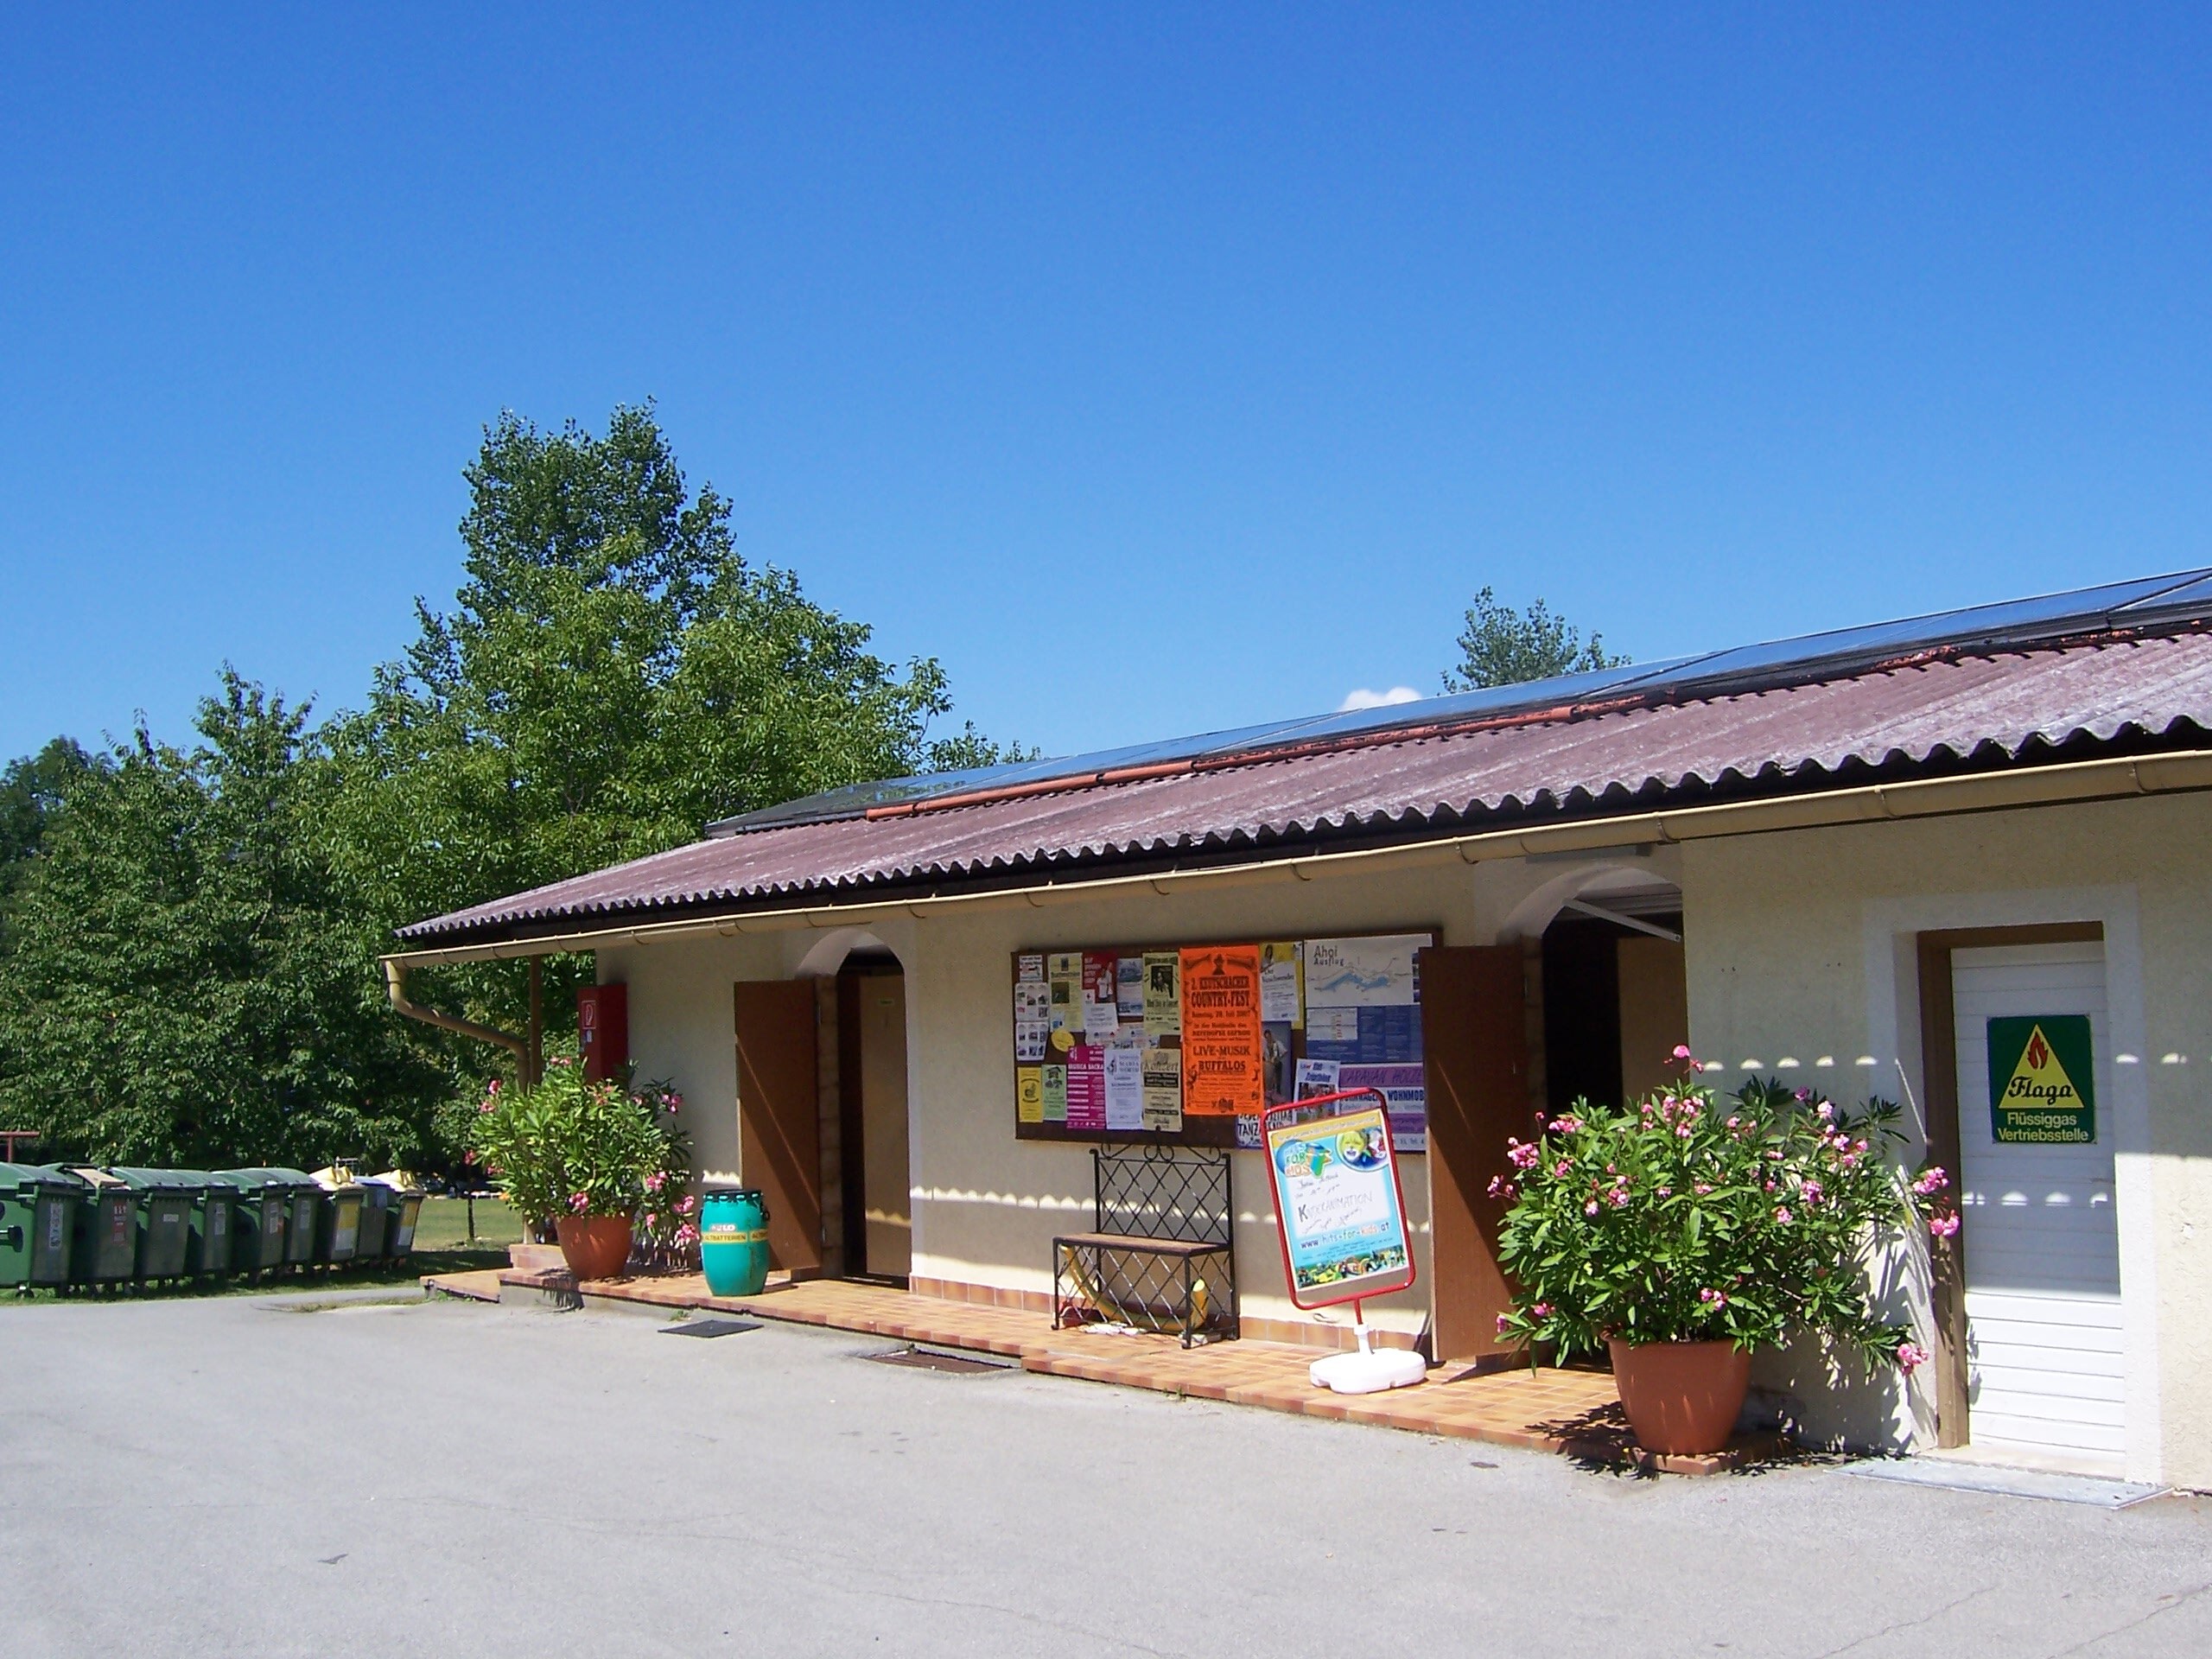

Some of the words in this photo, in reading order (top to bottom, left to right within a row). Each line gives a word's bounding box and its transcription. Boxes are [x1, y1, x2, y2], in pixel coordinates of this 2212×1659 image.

[1313, 944, 1338, 959] Ahoi
[1313, 957, 1344, 968] Ausflug
[1192, 1045, 1251, 1056] LIVE-MUSIK
[1198, 1060, 1246, 1071] BUFFALOS
[2007, 1076, 2074, 1106] Flaga
[2006, 1111, 2077, 1128] Flüssiggas
[1997, 1127, 2089, 1142] Vertriebsstelle
